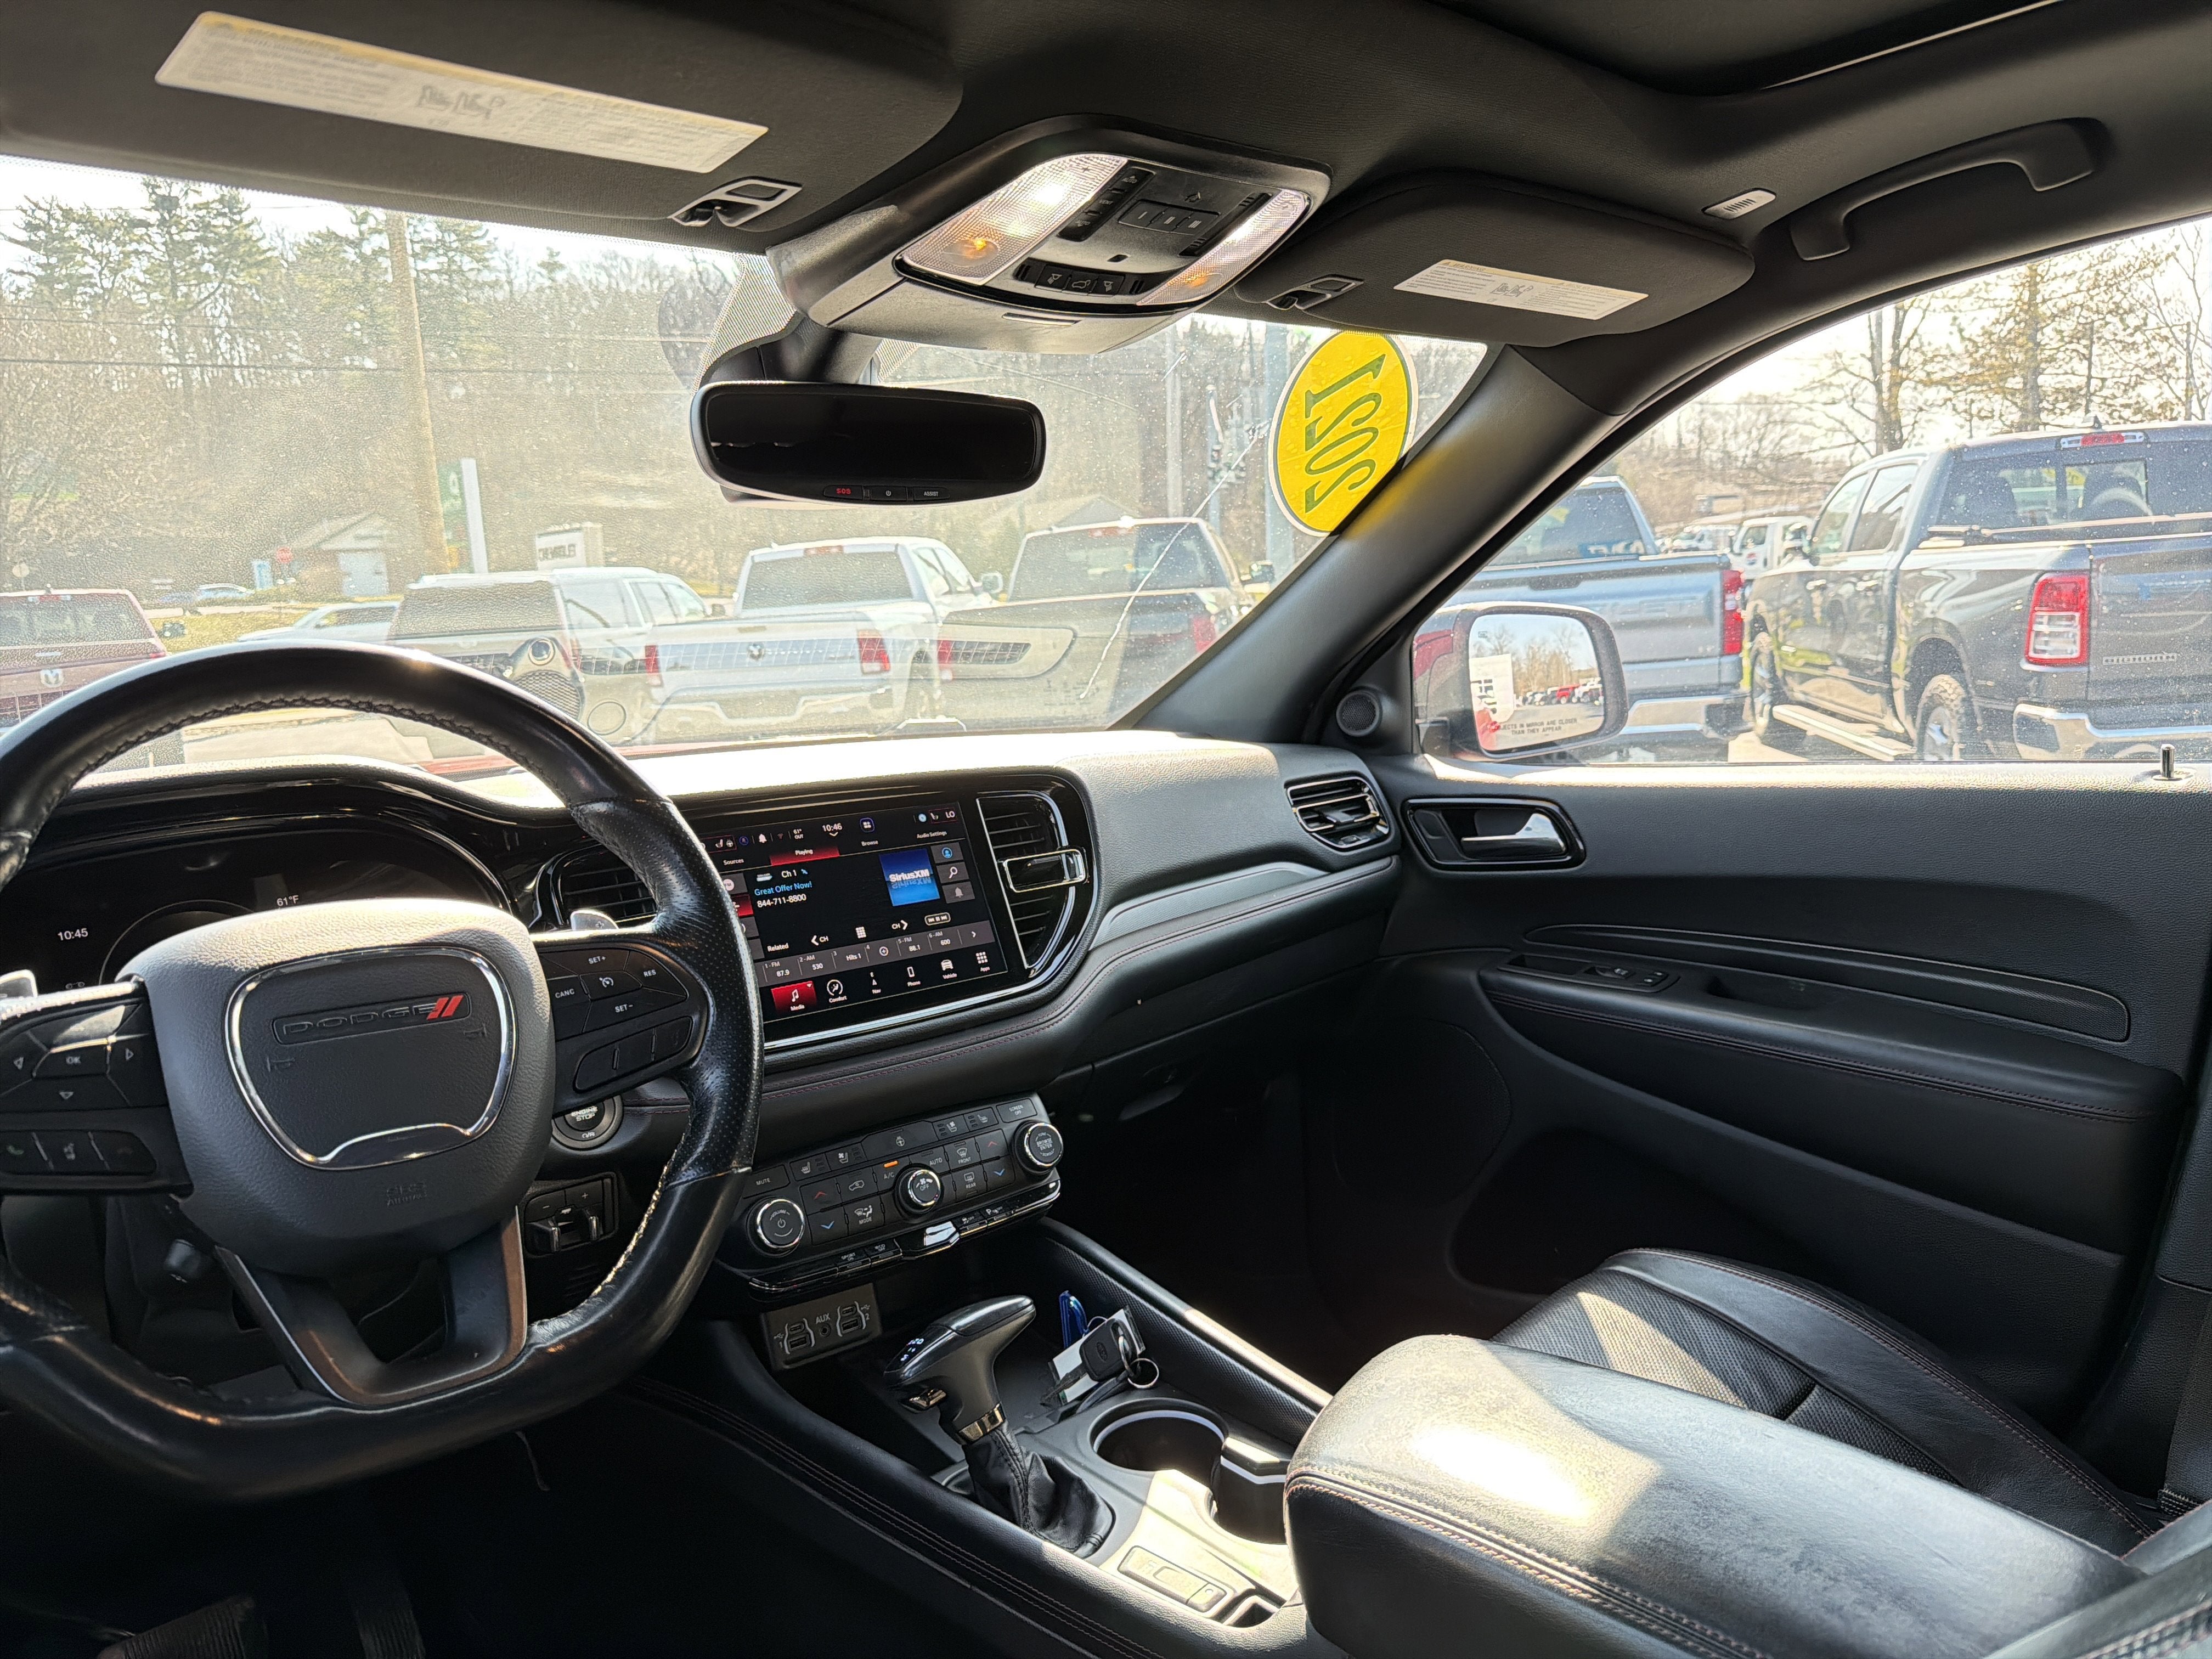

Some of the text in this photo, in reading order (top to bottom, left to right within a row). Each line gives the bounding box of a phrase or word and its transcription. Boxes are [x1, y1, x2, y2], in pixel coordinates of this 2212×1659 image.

[945, 810, 956, 819] LO
[821, 822, 843, 832] 10:46
[929, 830, 947, 838] Settings
[781, 870, 792, 878] Ch
[888, 868, 930, 883] SiriusXM
[754, 880, 812, 896] Great Offer Now!
[276, 894, 300, 907] 61°F
[757, 893, 807, 909] 844-711-8800
[57, 927, 89, 941] 10:45
[819, 935, 829, 943] CH
[767, 943, 789, 953] Related
[642, 968, 657, 978] RES
[776, 969, 790, 978] 87.9
[555, 988, 575, 999] CANC
[828, 995, 848, 1003] Comfort
[282, 1002, 437, 1035] DODGE
[66, 1056, 81, 1065] OK
[571, 1106, 598, 1117] ENGINE
[576, 1113, 595, 1122] STOP
[1036, 1137, 1053, 1146] BROWSE
[929, 1157, 943, 1166] AUTO
[755, 1177, 771, 1186] MUTE
[770, 1209, 786, 1218] VOLUME
[859, 1216, 872, 1224] MODE
[841, 1252, 856, 1260] SPORT
[815, 1313, 831, 1324] AUX
